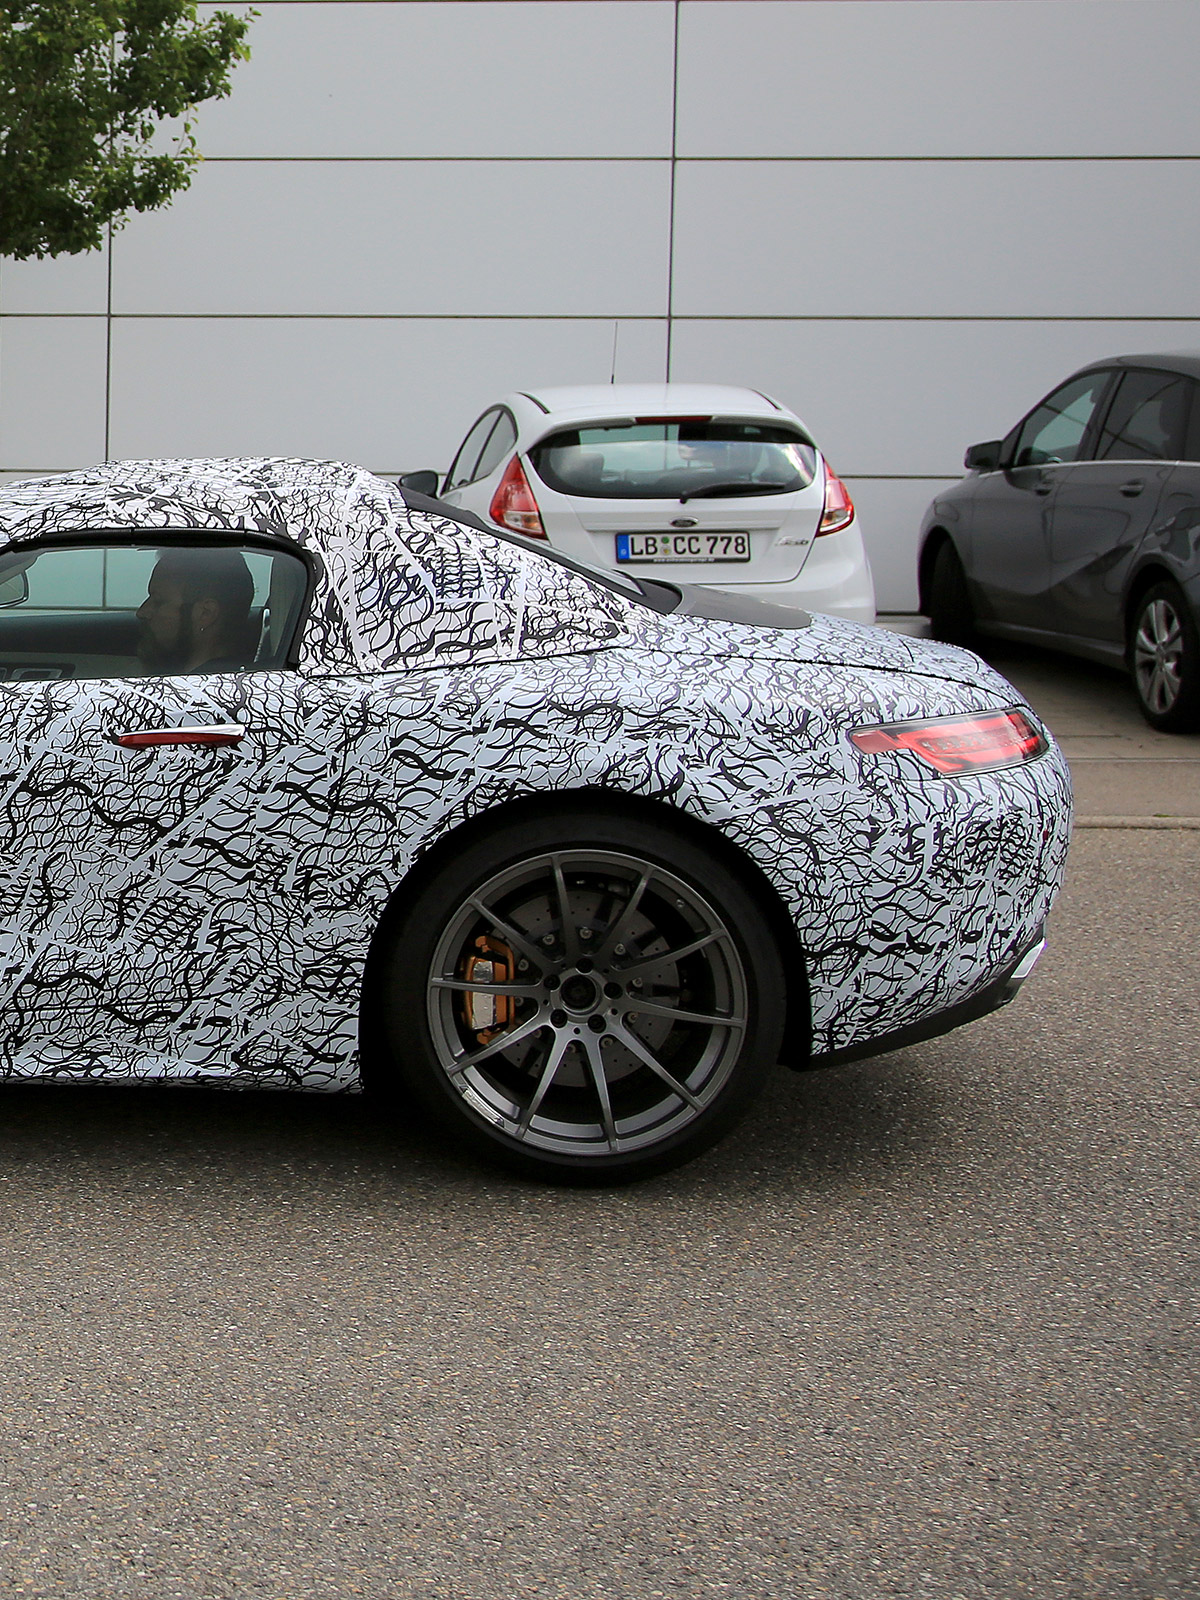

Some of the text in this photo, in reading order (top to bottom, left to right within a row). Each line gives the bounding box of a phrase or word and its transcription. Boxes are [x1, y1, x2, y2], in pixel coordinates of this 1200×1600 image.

[630, 535, 747, 556] LB CC 778
